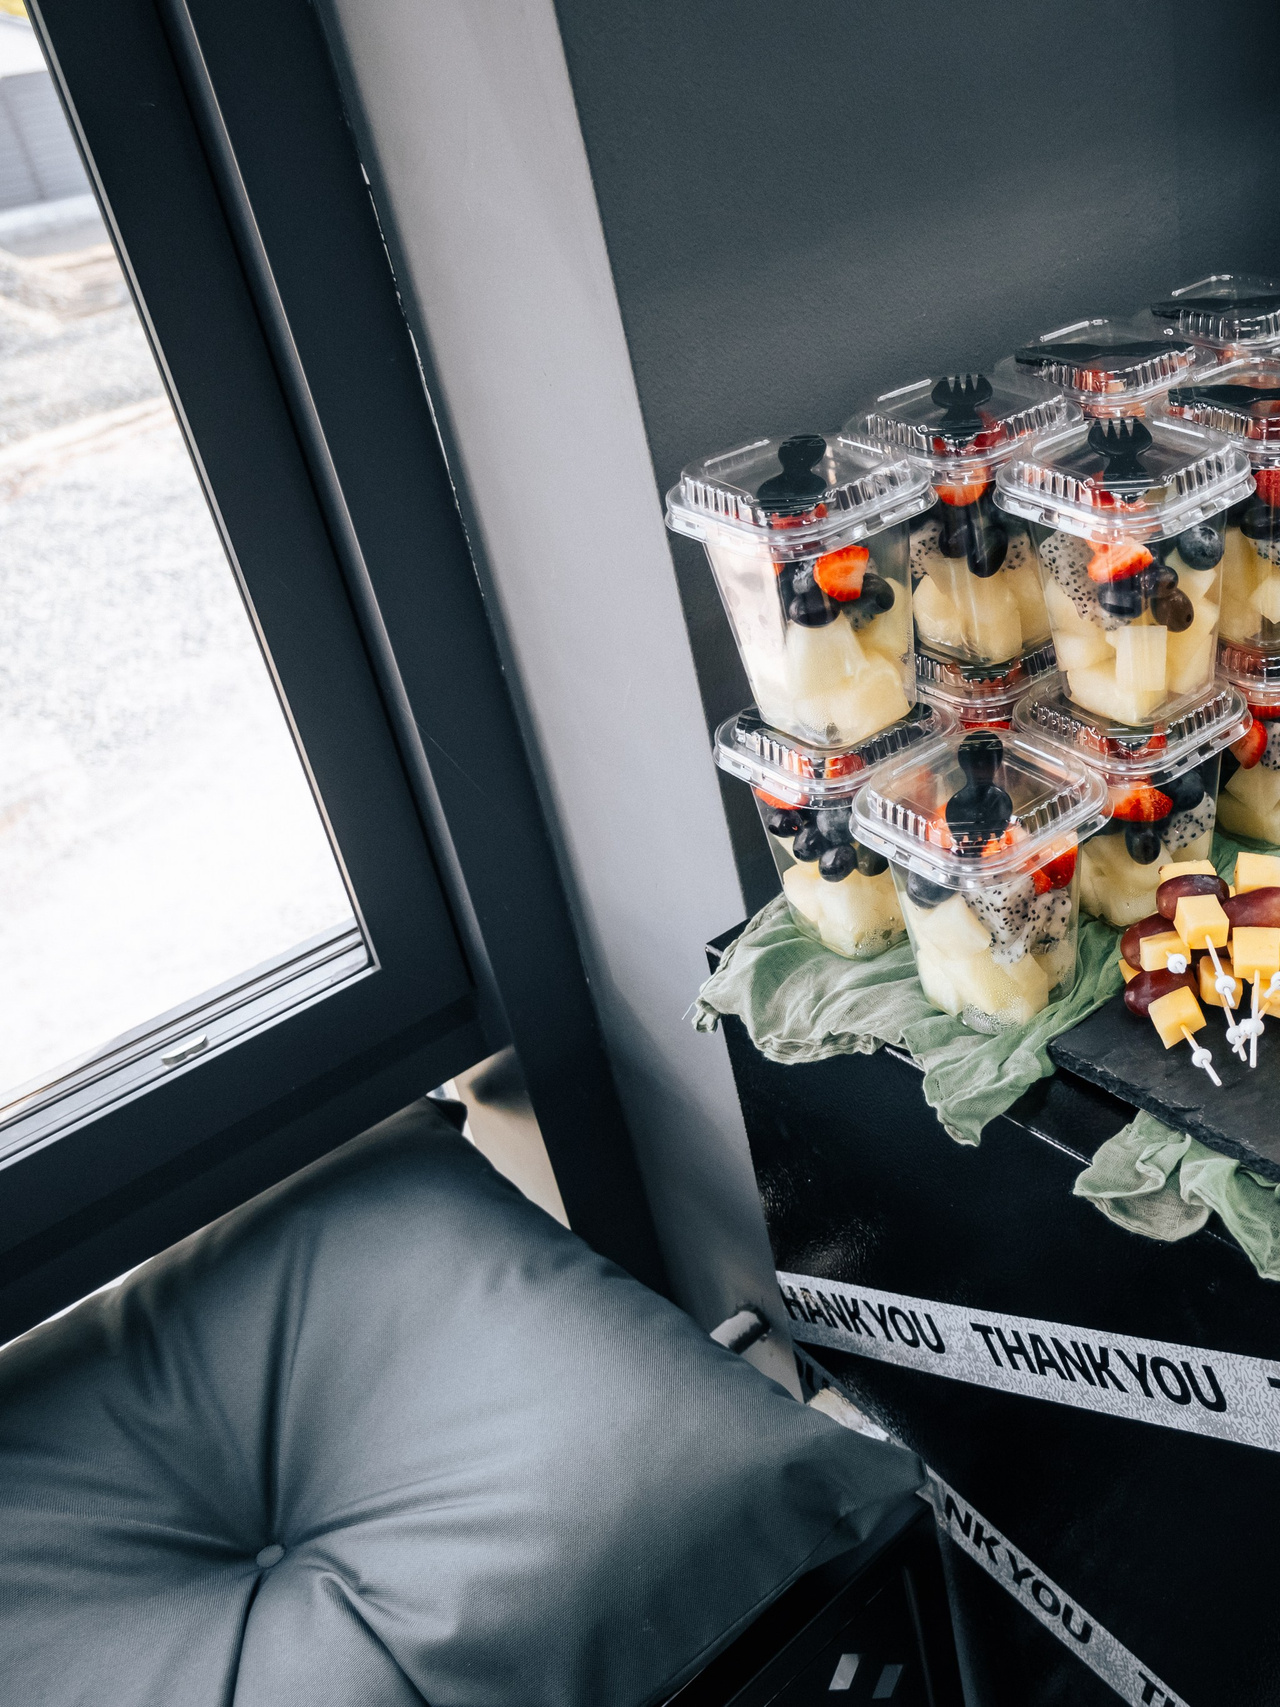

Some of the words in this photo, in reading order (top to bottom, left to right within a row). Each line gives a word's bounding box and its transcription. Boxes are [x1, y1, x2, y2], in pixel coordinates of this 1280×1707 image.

[863, 1299, 946, 1355] YOU
[970, 1321, 1130, 1394] THANK
[1113, 1348, 1228, 1413] YOU
[1006, 1548, 1093, 1644] YOU
